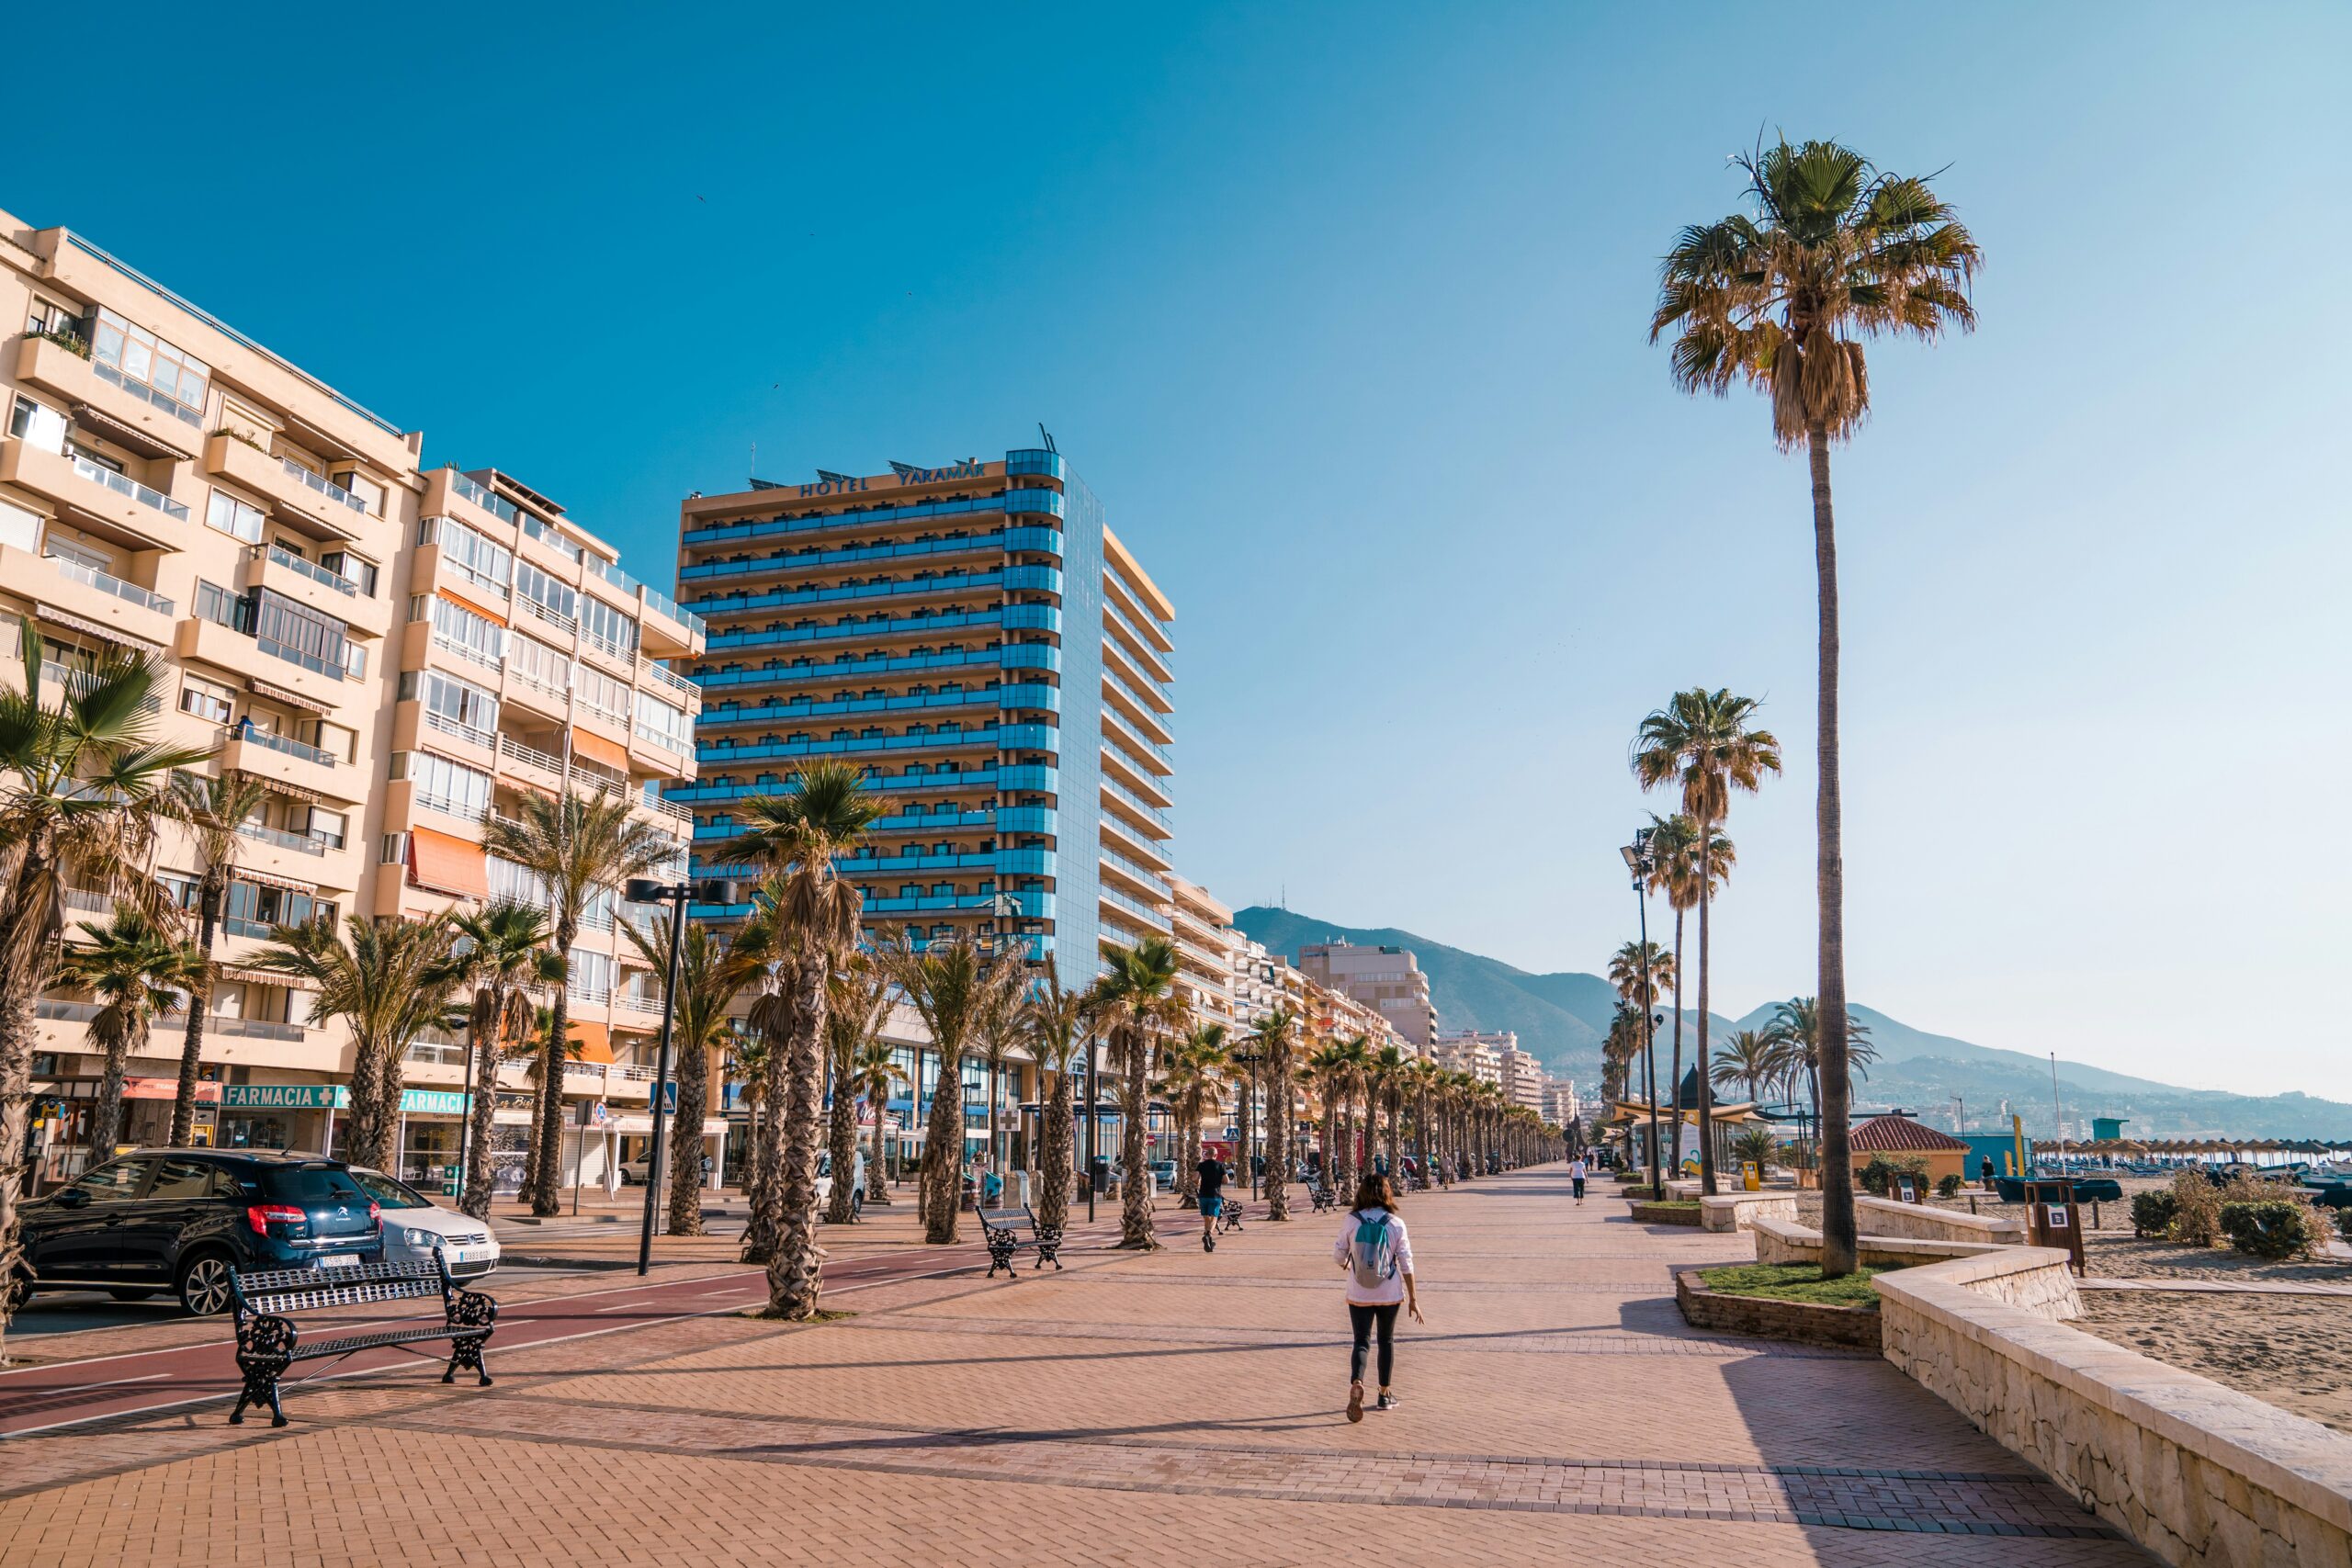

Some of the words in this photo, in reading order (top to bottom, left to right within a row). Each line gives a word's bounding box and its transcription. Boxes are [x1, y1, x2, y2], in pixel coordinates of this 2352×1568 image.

[799, 477, 869, 497] HOTEL
[897, 463, 985, 486] YARAMAR
[226, 1087, 312, 1105] FARMACIA
[400, 1091, 469, 1112] FARMACI
